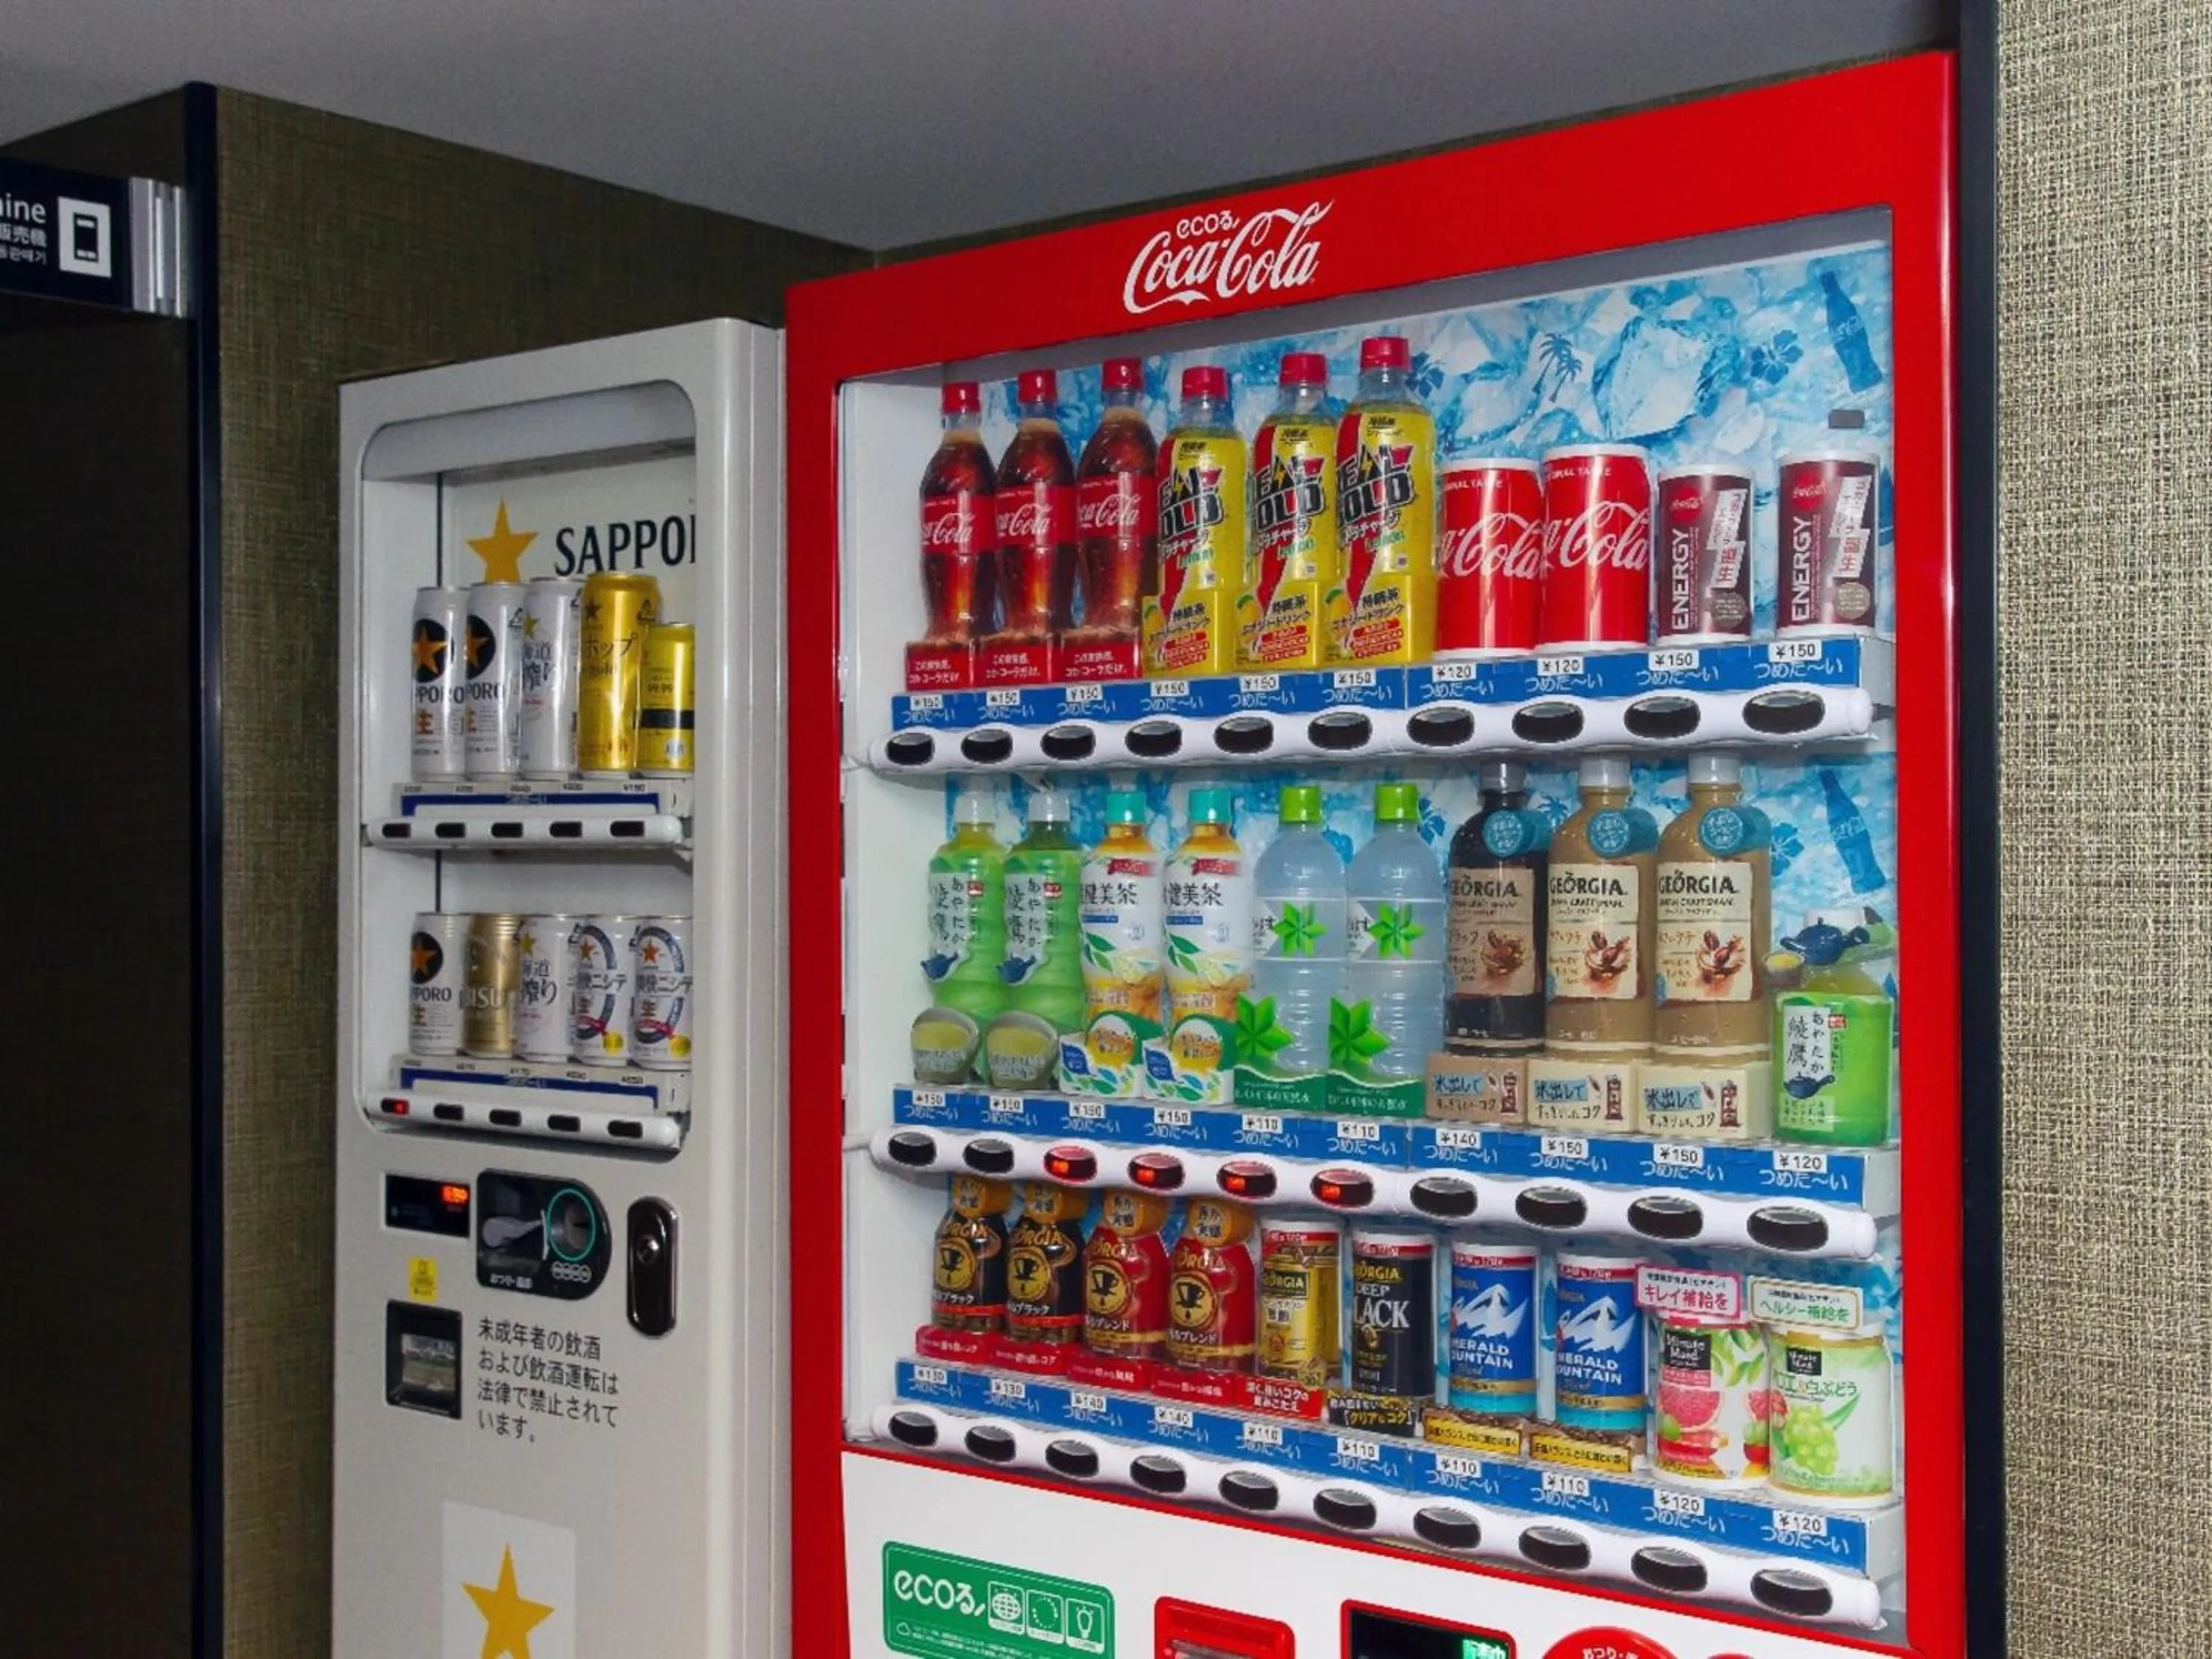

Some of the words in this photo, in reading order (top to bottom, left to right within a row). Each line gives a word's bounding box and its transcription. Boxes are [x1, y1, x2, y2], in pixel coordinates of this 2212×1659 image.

[1672, 528, 1690, 630] ENERGY
[1791, 516, 1812, 622] ENERGY
[1655, 653, 1693, 667] ¥150
[1775, 644, 1817, 659] ¥150
[1543, 659, 1580, 673] ¥120
[1812, 1010, 1826, 1074] あやたか
[1440, 1132, 1478, 1147] ¥140
[1547, 1140, 1582, 1155] ¥150
[1659, 1146, 1699, 1164] ¥150
[1778, 1154, 1823, 1171] ¥120
[1644, 1283, 1729, 1311] キレイ補給を
[1354, 1298, 1410, 1329] LACK
[1759, 1298, 1851, 1322] ヘルシー補給を
[479, 1316, 601, 1360] 未成年者の飲酒
[479, 1349, 619, 1396] および飲酒運転は
[478, 1380, 618, 1427] 法律で禁止されて
[479, 1410, 535, 1443] います。
[1441, 1458, 1477, 1476] ¥110
[1548, 1476, 1585, 1495] ¥110
[1658, 1492, 1700, 1513] ¥120
[1778, 1512, 1822, 1533] ¥120
